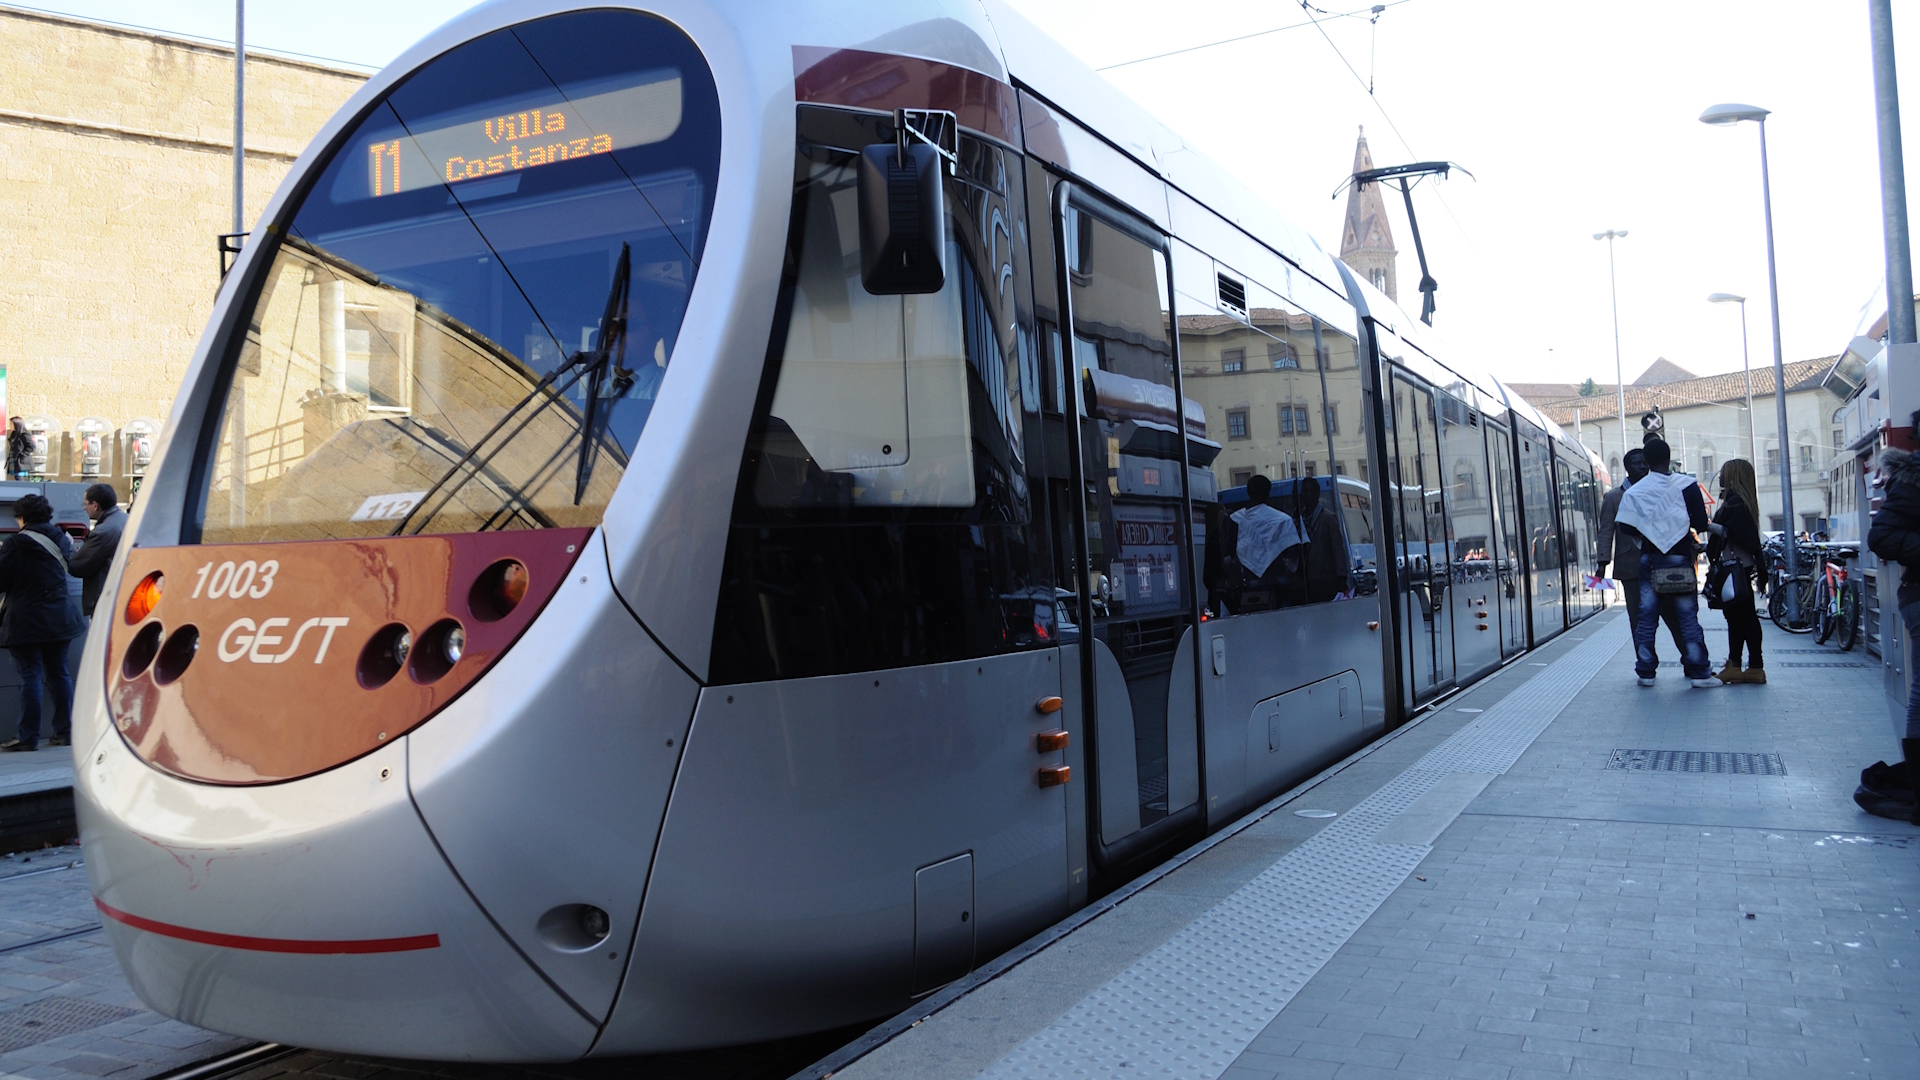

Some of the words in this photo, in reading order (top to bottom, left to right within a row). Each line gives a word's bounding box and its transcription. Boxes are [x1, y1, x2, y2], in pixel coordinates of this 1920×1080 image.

[485, 110, 565, 144] Villa
[371, 141, 400, 196] T1
[446, 134, 612, 182] Costanza
[366, 500, 412, 519] 112
[191, 560, 279, 599] 1003
[217, 617, 350, 664] GEST
